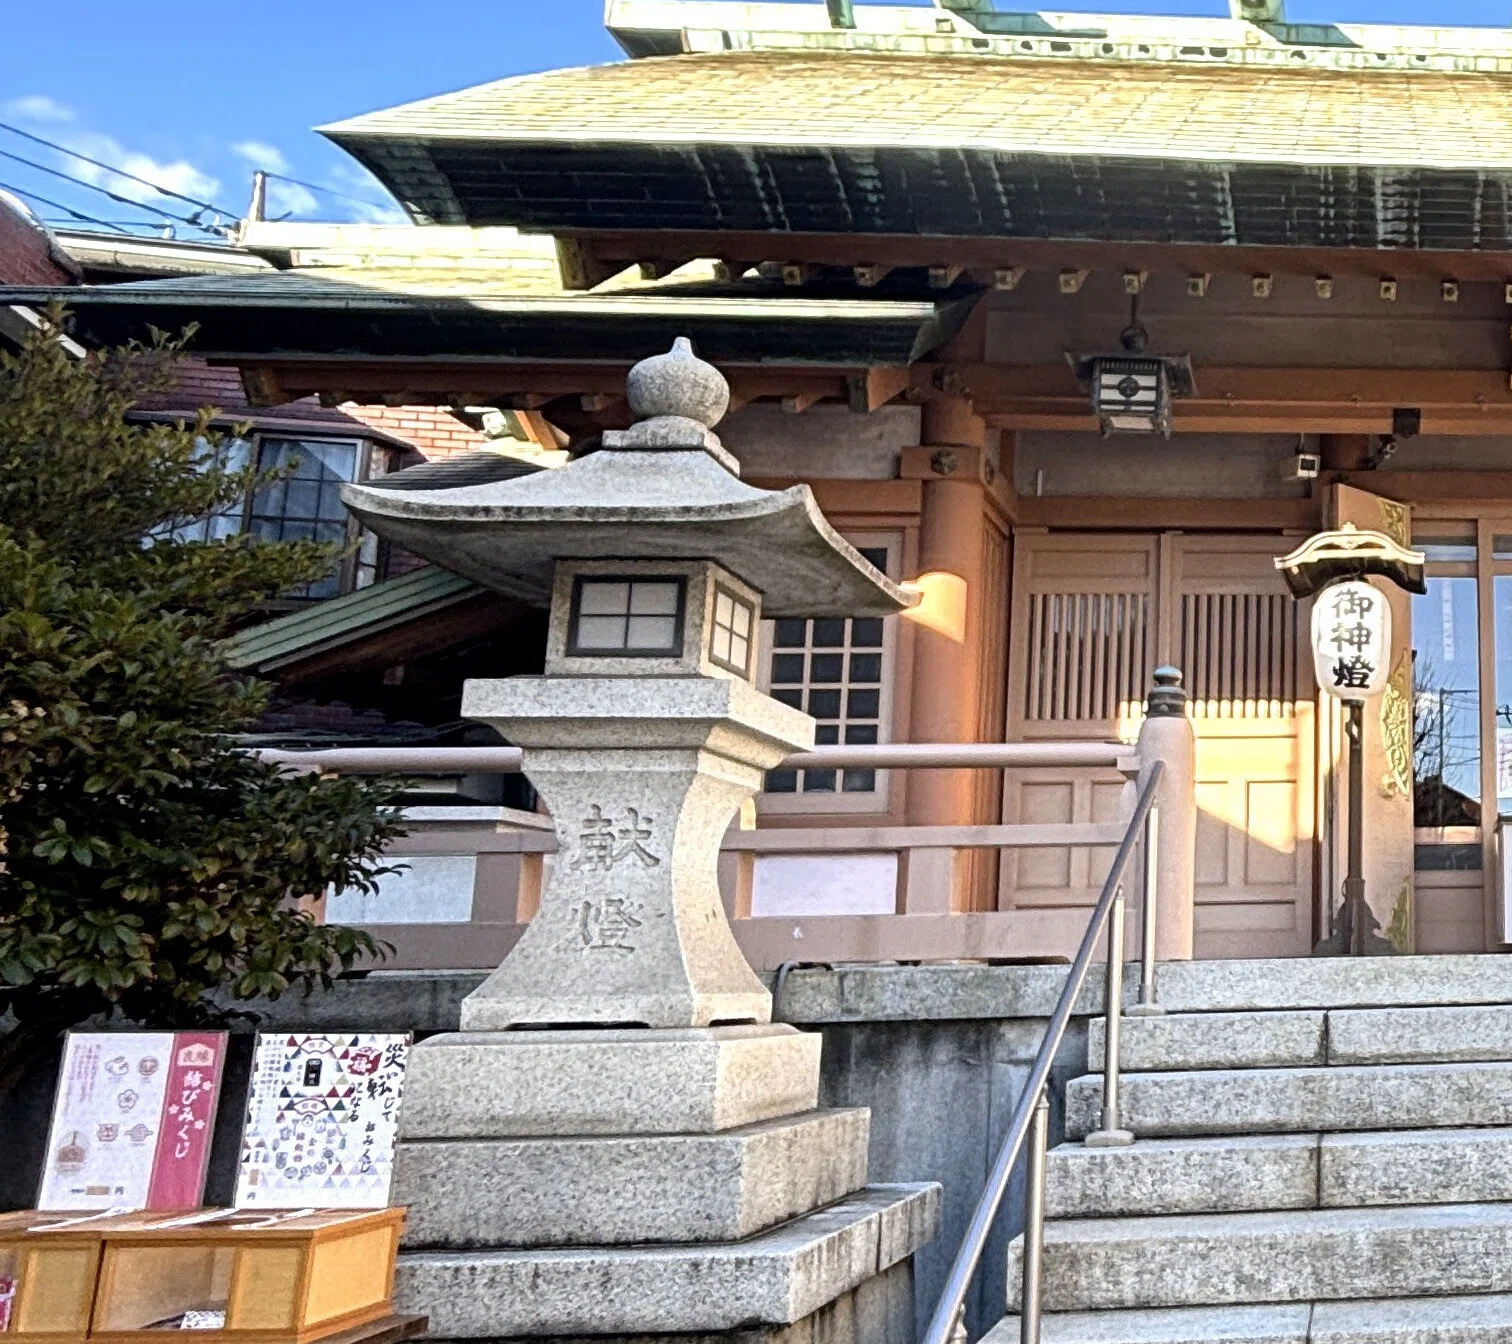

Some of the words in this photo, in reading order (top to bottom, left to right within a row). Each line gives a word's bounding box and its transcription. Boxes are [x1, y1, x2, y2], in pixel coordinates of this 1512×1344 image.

[1331, 589, 1375, 689] 御神燈
[175, 1070, 203, 1159] 結びみくじ
[367, 1044, 405, 1122] 災い転じて
[360, 1121, 375, 1174] おみくじ
